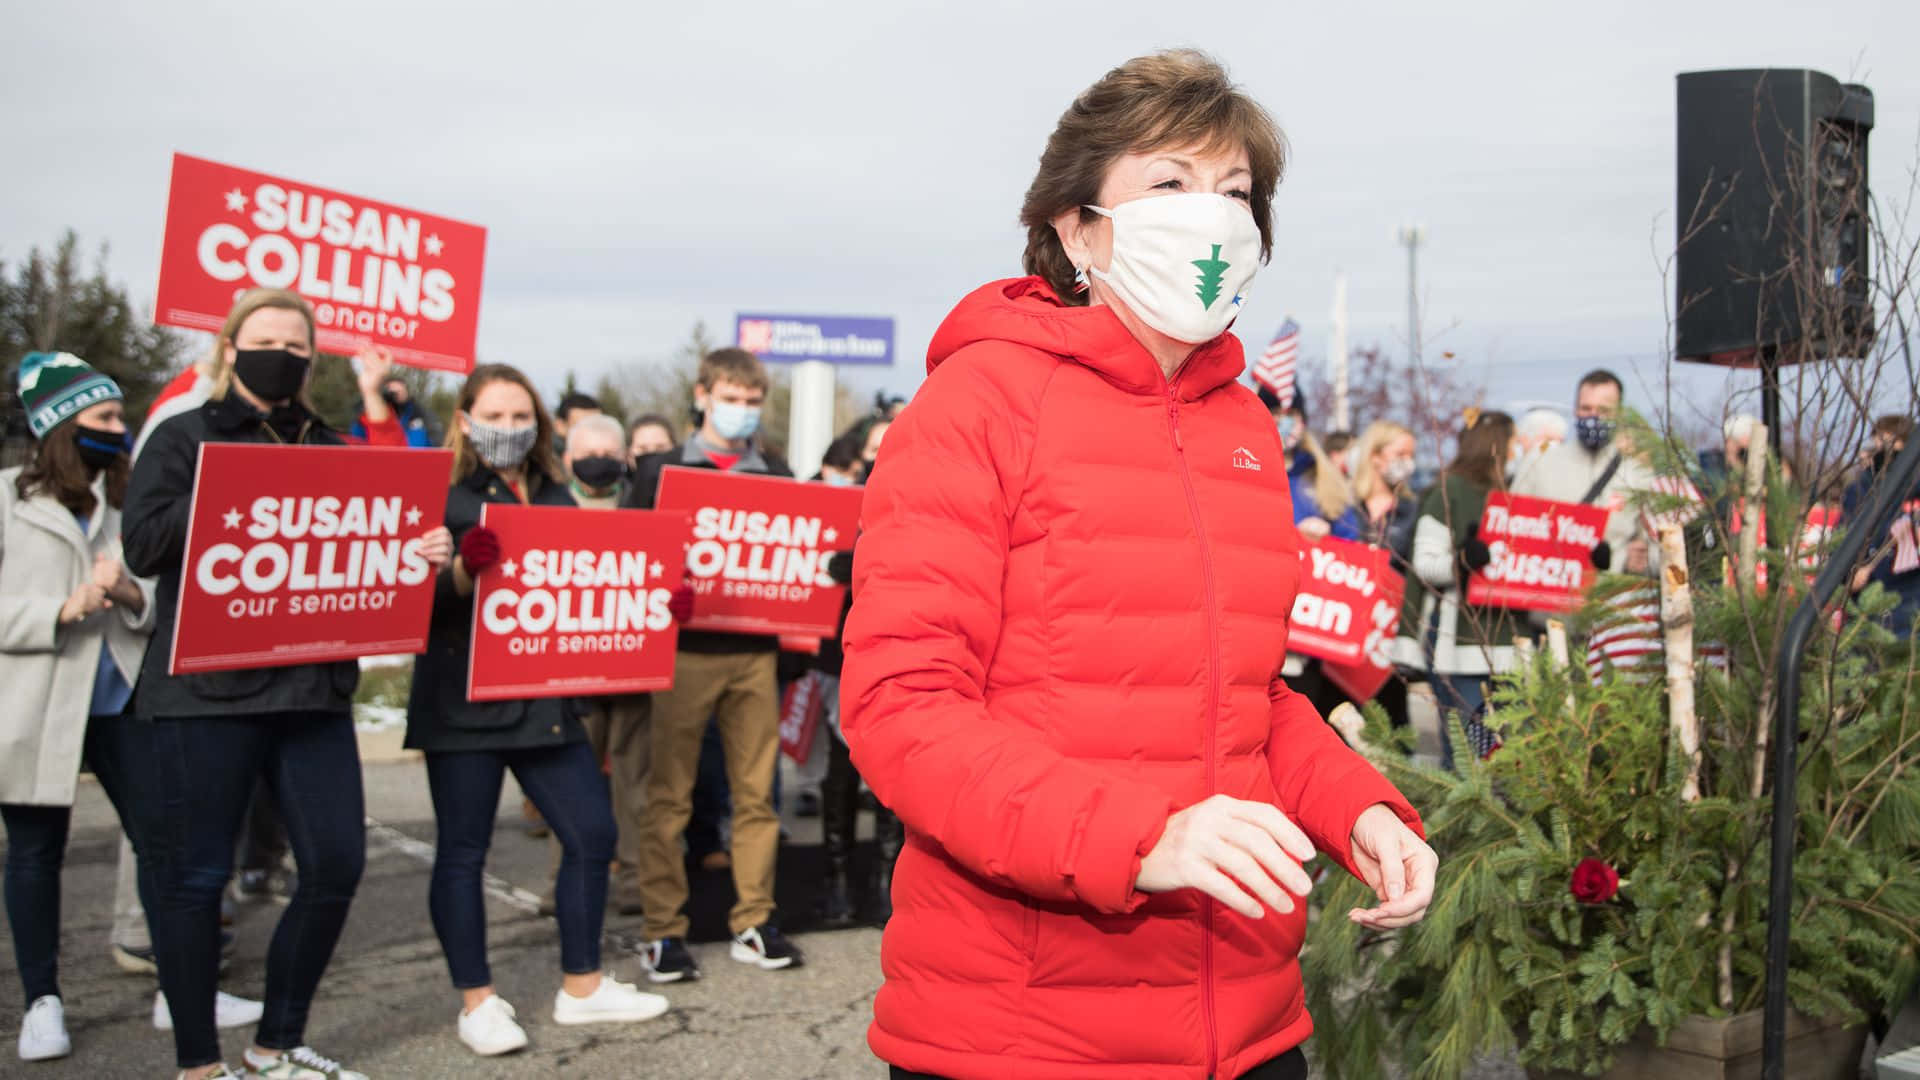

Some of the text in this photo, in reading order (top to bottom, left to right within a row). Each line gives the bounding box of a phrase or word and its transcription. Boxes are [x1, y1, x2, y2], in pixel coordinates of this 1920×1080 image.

[252, 183, 421, 261] SUSAN
[197, 223, 455, 322] COLLINS
[247, 496, 402, 540] SUSAN
[692, 506, 822, 548] SUSAN
[1486, 505, 1550, 540] Thank
[196, 537, 430, 595] COLLINS
[520, 549, 646, 588] SUSAN
[683, 540, 838, 588] OLLINS
[1310, 547, 1376, 597] You,
[1483, 539, 1582, 588] Susan
[227, 590, 397, 619] our senator
[482, 588, 673, 635] COLLINS
[722, 579, 812, 602] senator
[508, 632, 646, 656] our senator
